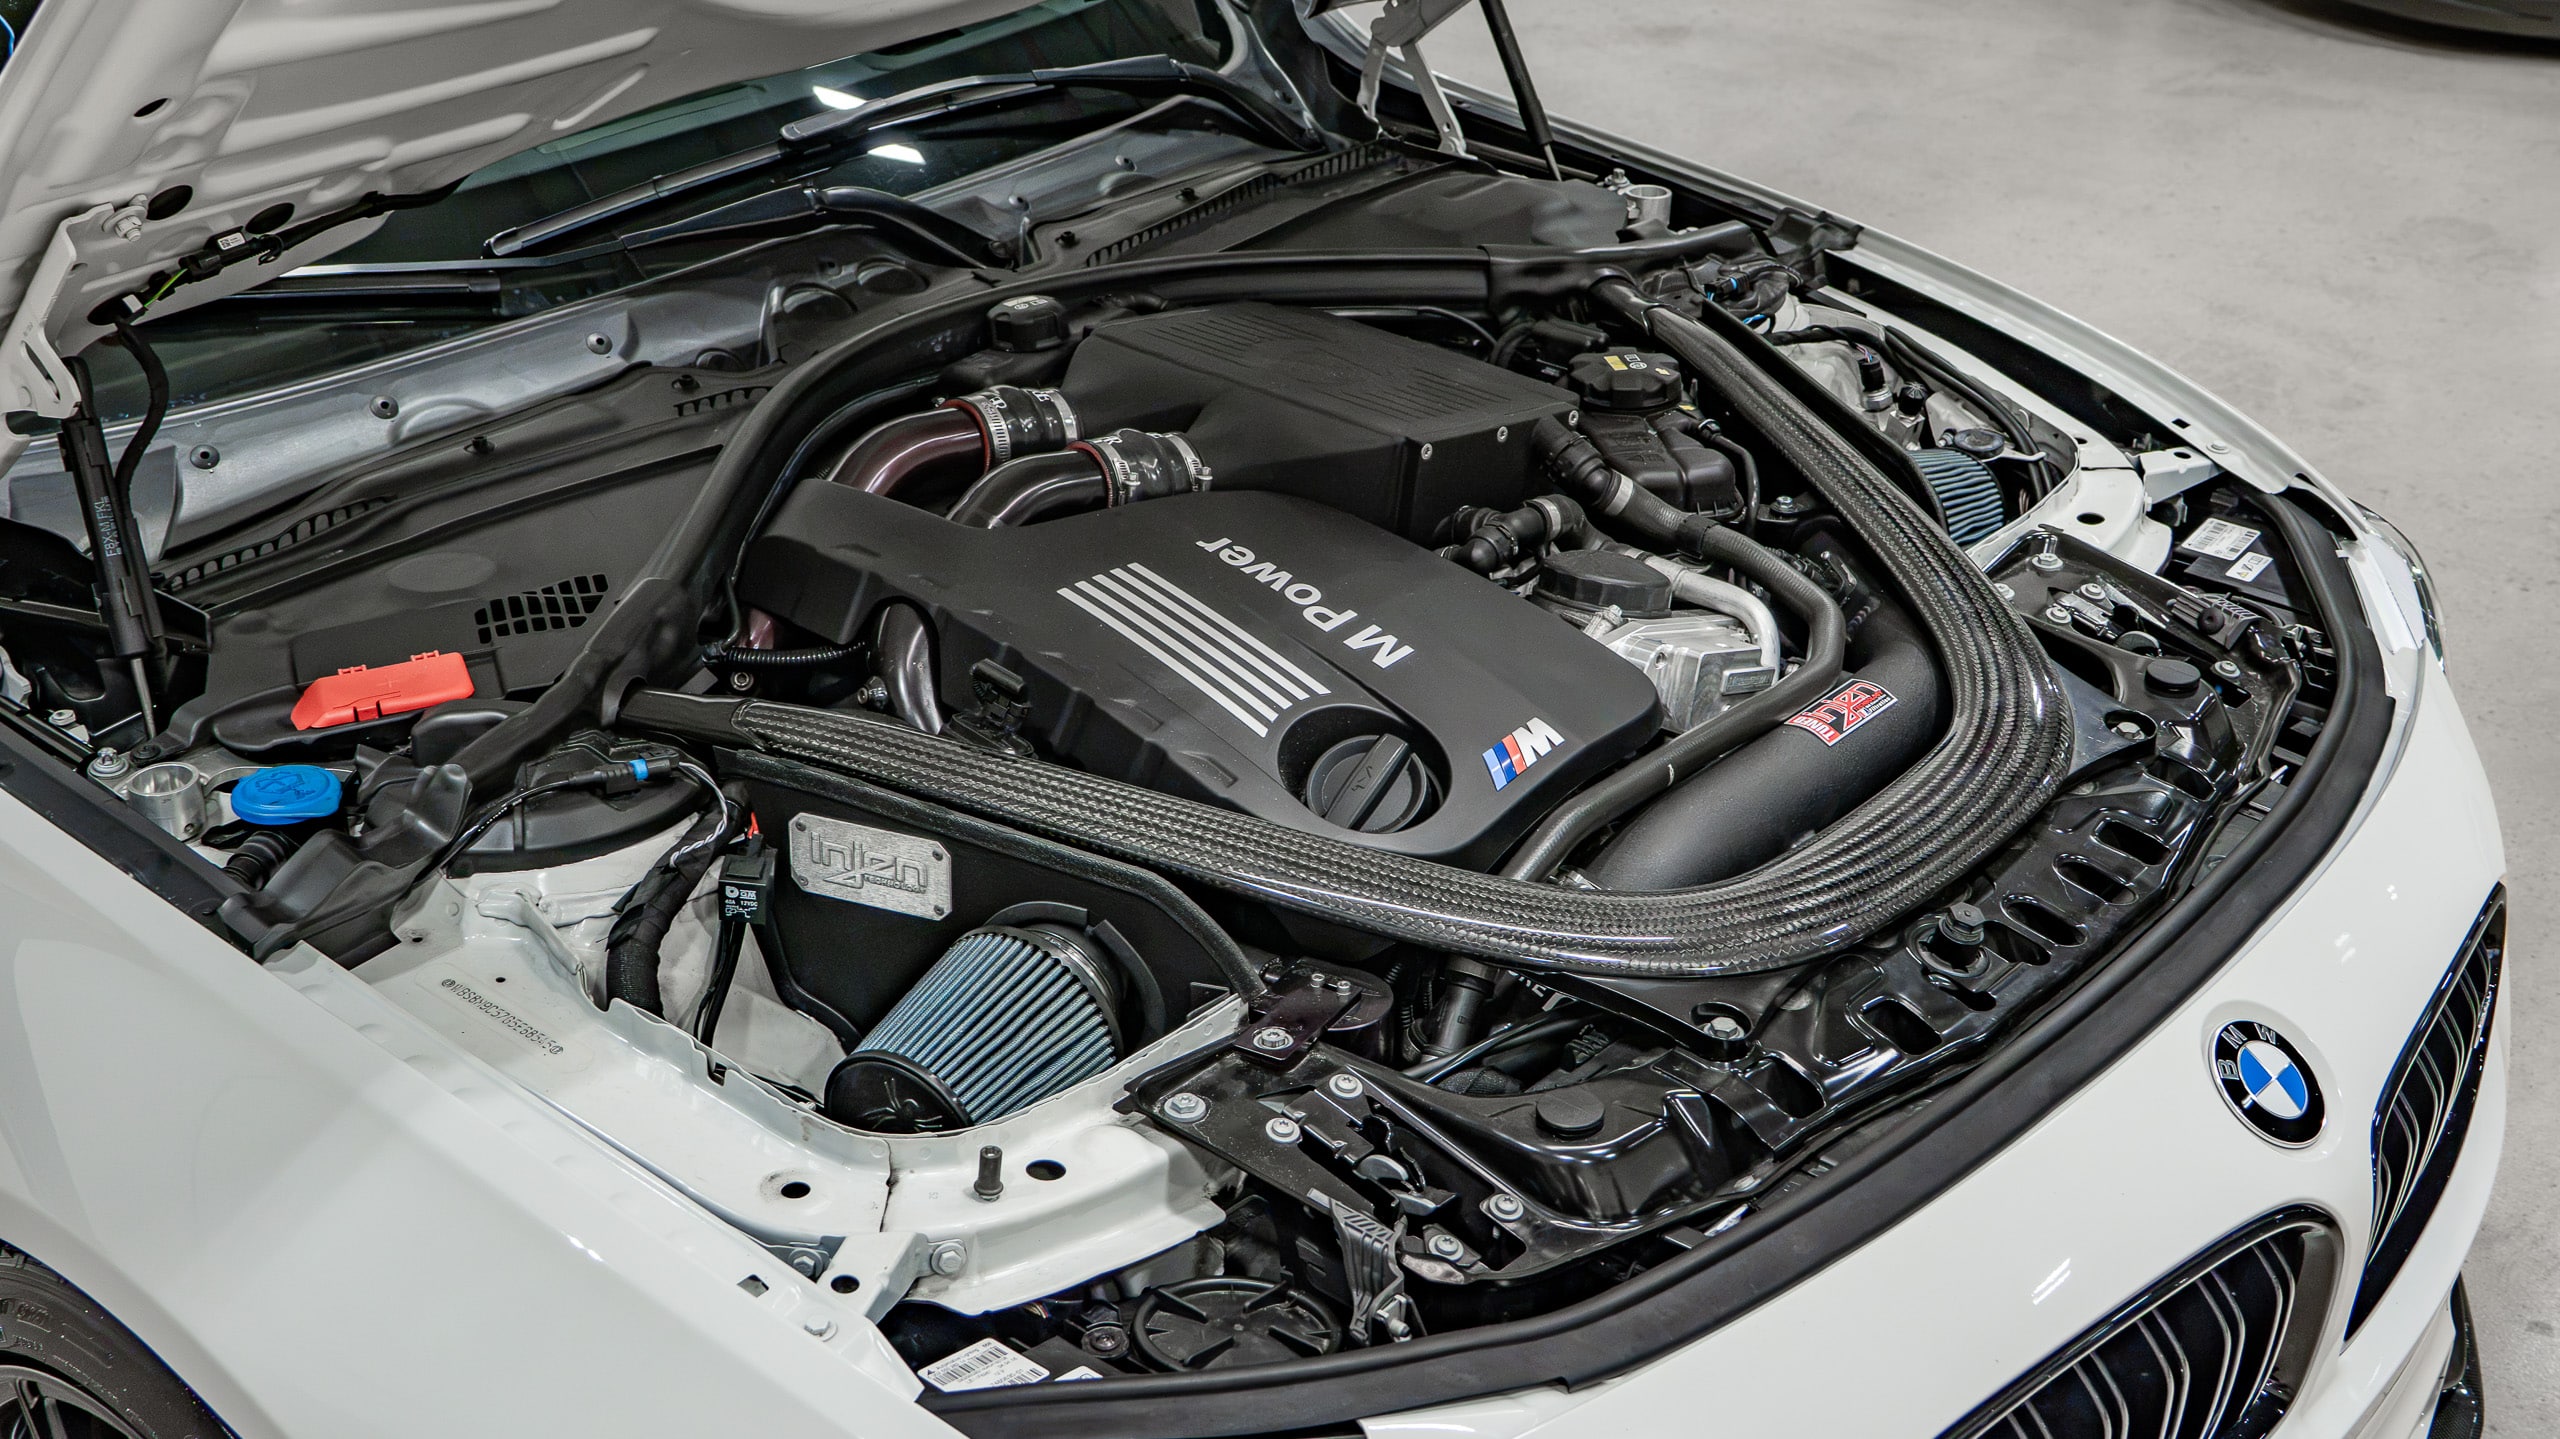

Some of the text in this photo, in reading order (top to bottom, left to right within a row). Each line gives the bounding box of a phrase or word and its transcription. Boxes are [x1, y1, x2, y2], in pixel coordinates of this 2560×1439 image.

[1195, 537, 1415, 669] M Power
[1793, 715, 1836, 741] TUNED
[2217, 1022, 2277, 1080] BMW
